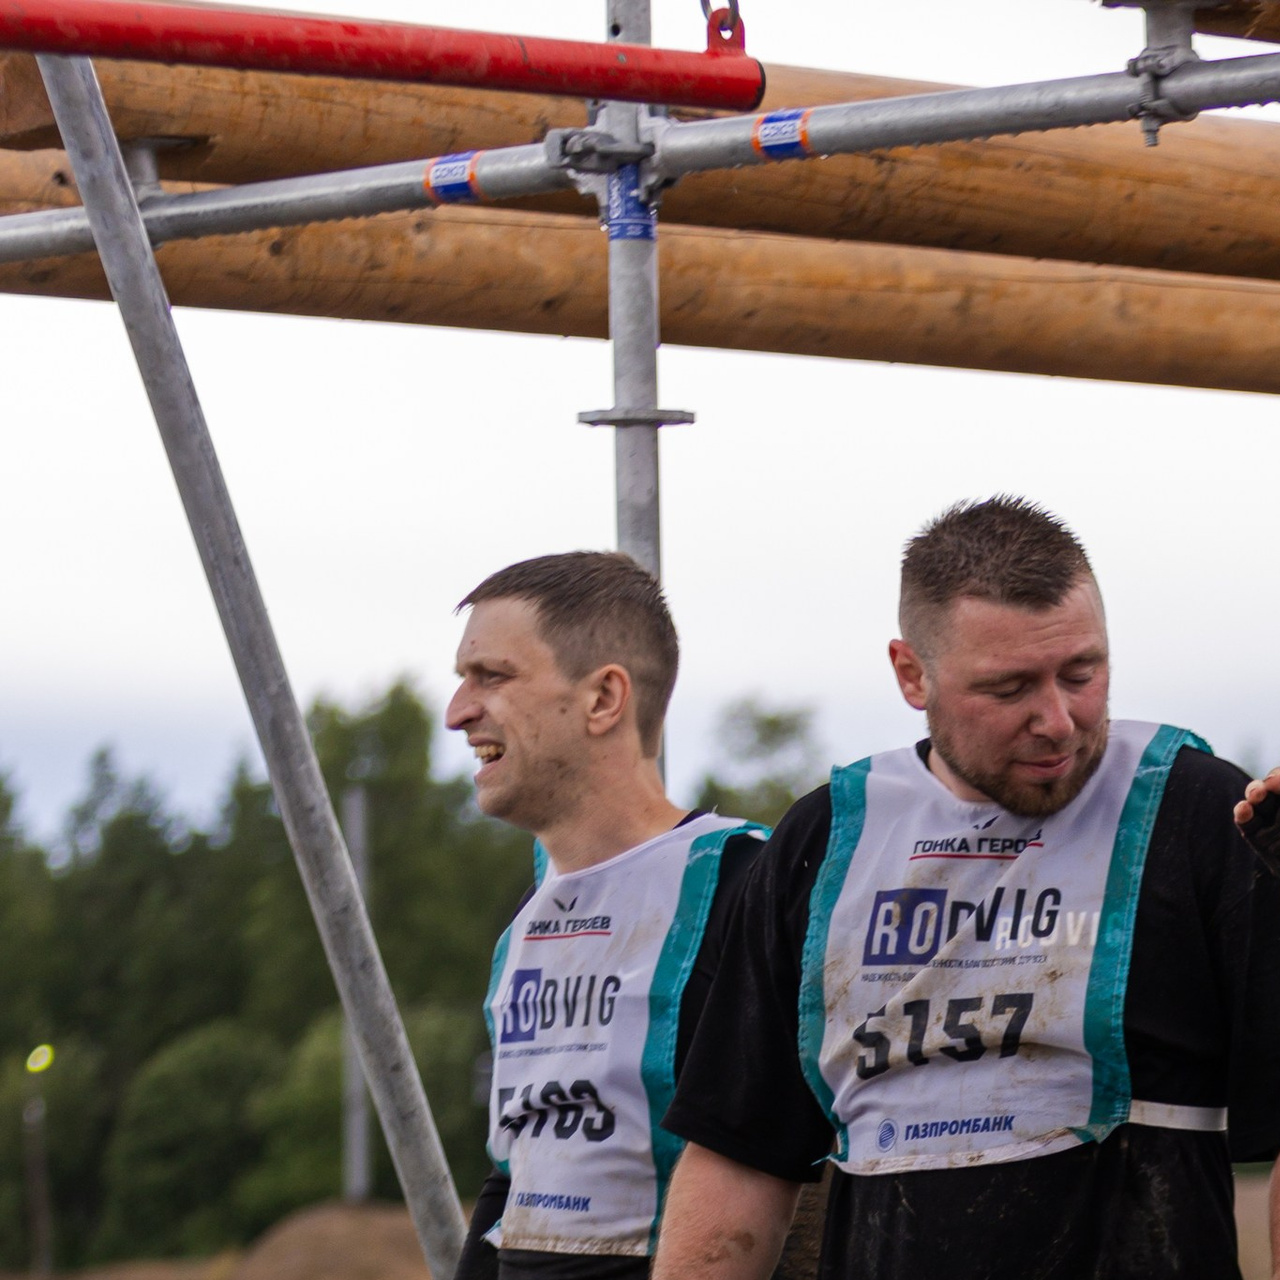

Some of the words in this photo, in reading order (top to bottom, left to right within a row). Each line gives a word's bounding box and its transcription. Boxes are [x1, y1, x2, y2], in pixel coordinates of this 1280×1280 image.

[913, 838, 970, 854] ГОНКА
[977, 829, 1042, 854] ГЕРО
[853, 993, 1034, 1081] 5157
[905, 1116, 1016, 1141] ГАЗПРОМБАНК
